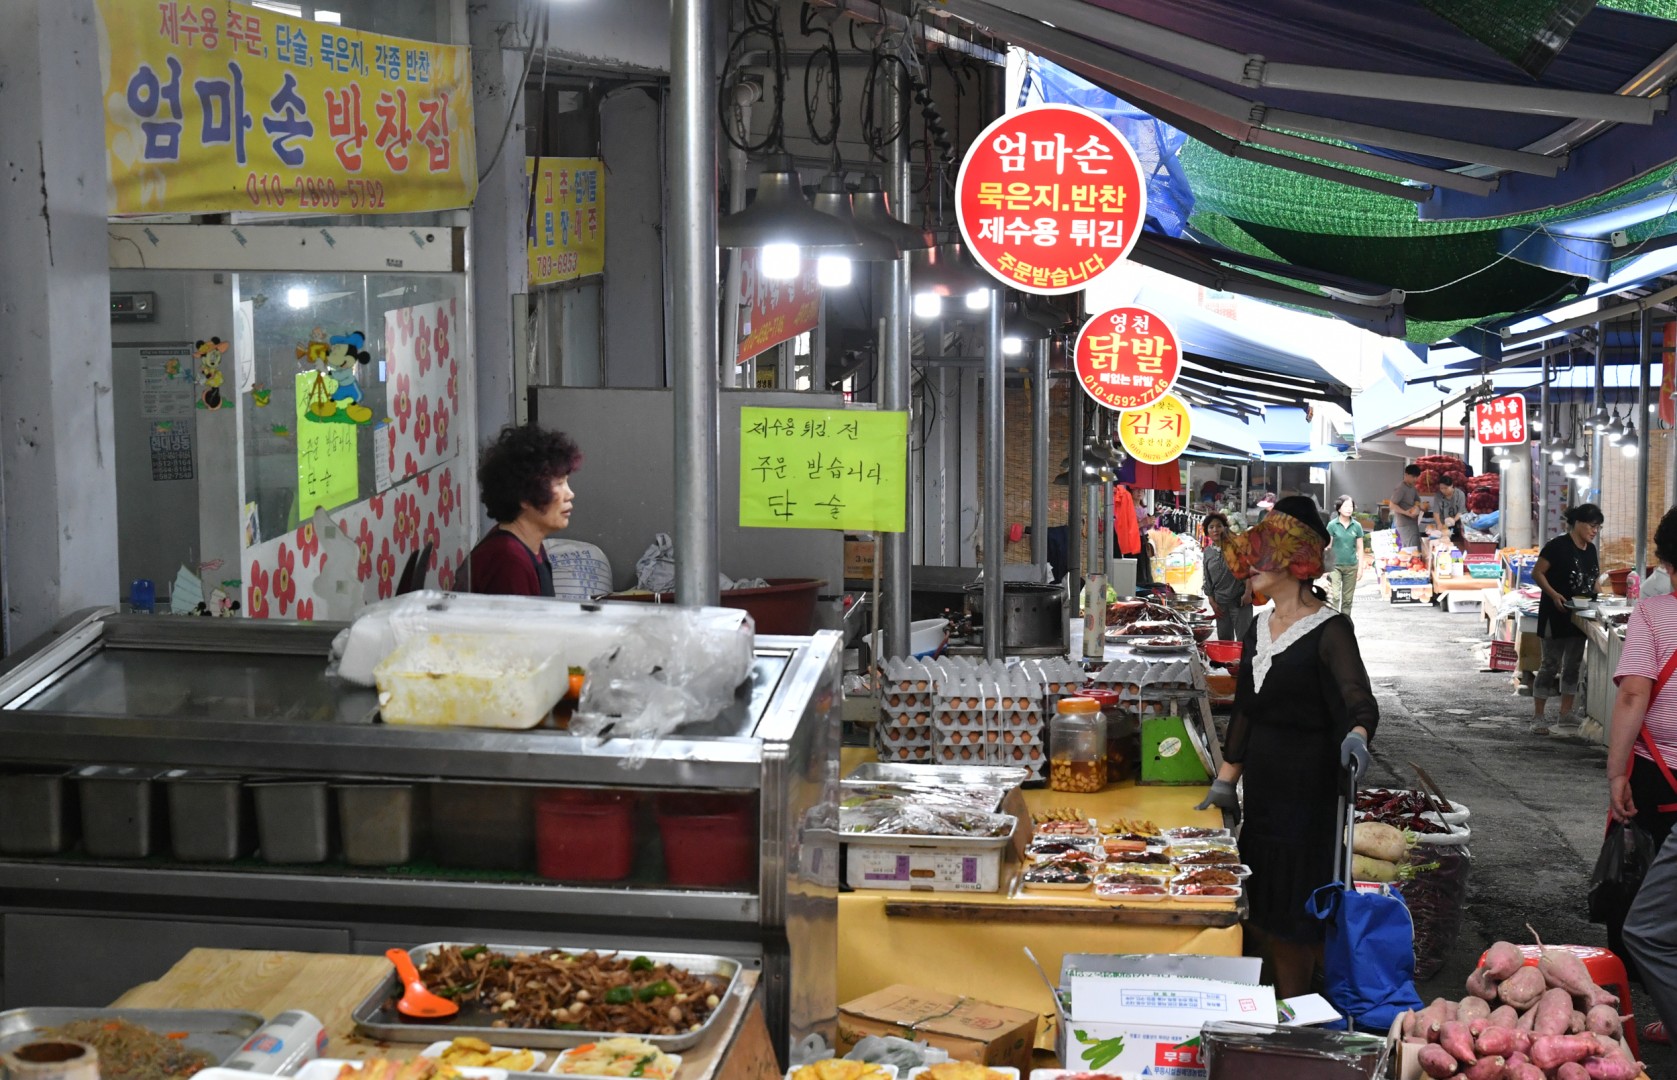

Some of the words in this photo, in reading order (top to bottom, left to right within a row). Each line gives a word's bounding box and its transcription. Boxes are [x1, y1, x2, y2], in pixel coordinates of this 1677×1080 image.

[159, 2, 219, 49] 제수용
[375, 44, 401, 82] 각종
[405, 50, 431, 83] 반찬
[127, 56, 314, 167] 엄마손
[324, 82, 450, 172] 반찬집
[992, 131, 1114, 175] 엄마손
[977, 183, 1127, 213] 묵은지.반찬
[978, 216, 1059, 247] 제수용
[1069, 218, 1123, 248] 튀김
[996, 251, 1106, 287] 주문받습니다
[1110, 313, 1150, 334] 영천
[1087, 333, 1172, 374] 닭발
[746, 417, 796, 438] 제수용
[837, 419, 858, 440] 전
[1127, 411, 1182, 437] 김치
[1480, 417, 1523, 441] 추어탕
